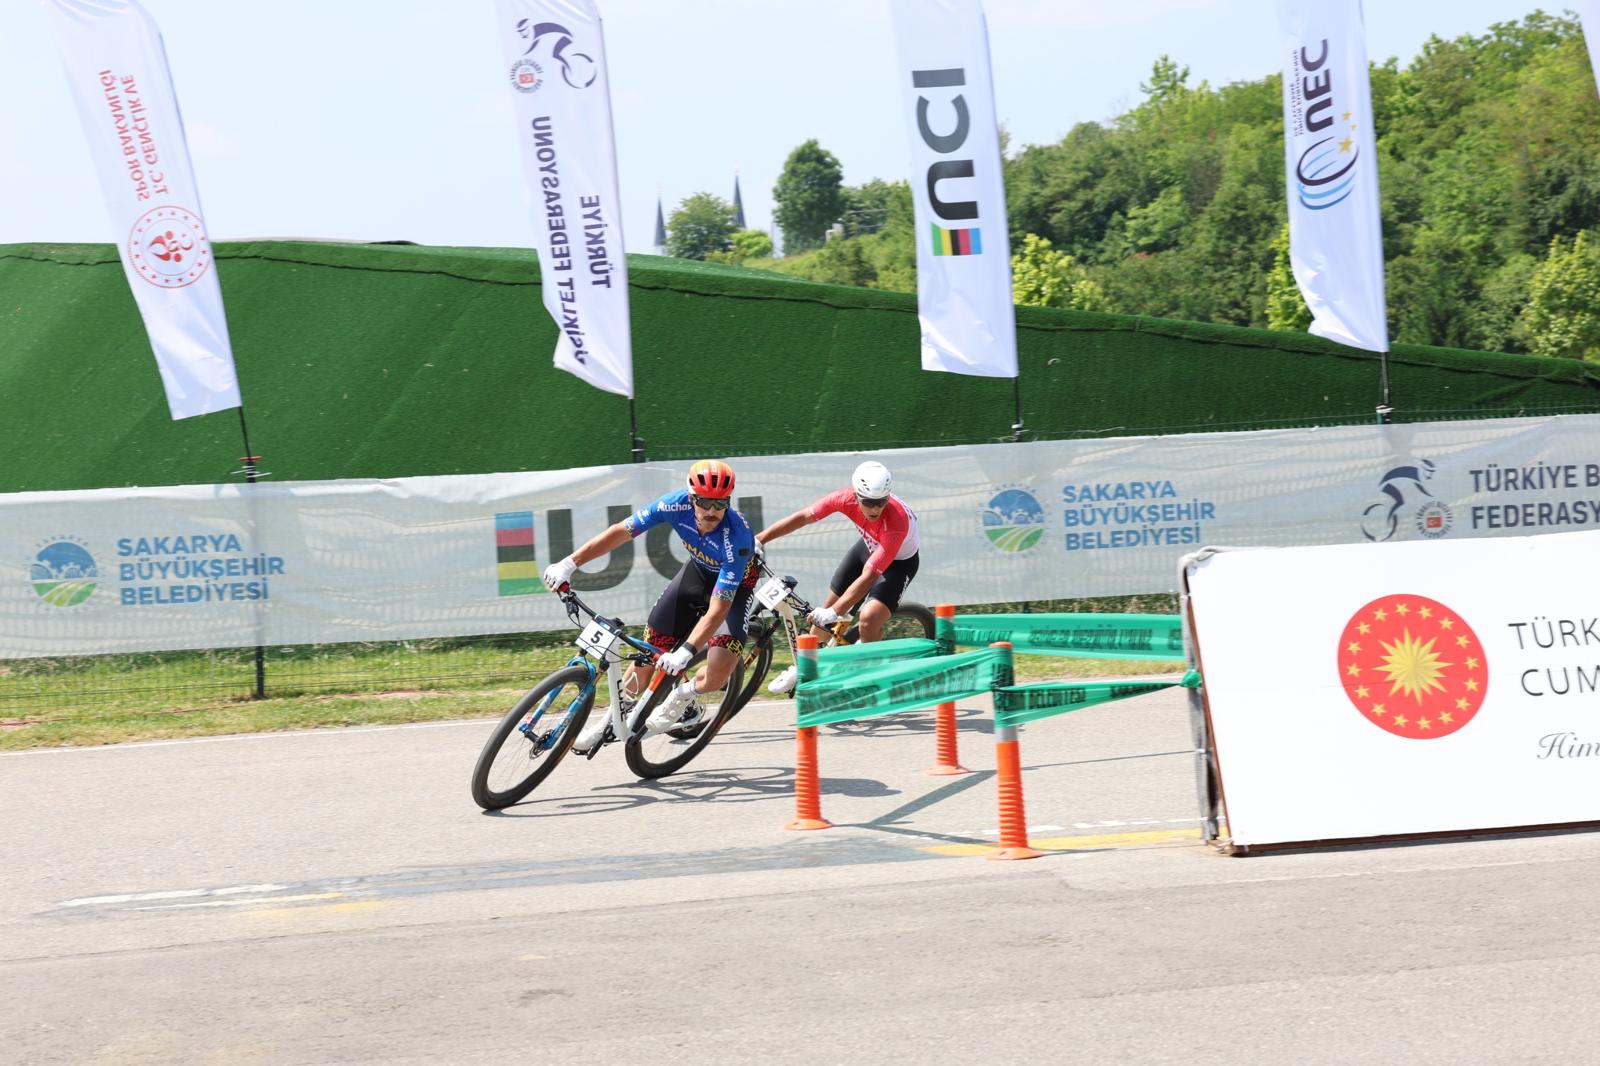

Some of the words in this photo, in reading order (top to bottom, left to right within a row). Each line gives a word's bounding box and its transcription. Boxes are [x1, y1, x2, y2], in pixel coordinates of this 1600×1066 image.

[1469, 461, 1577, 493] TÜRKİYE
[1063, 480, 1176, 503] SAKARYA
[1064, 499, 1216, 527] BÜYÜKŞEHİR
[117, 534, 242, 557] SAKARYA
[723, 527, 735, 563] Auchan
[1065, 522, 1200, 550] BELEDİYESİ
[119, 552, 285, 582] BÜYÜKŞEHİR
[120, 577, 270, 606] BELEDİYESİ
[766, 587, 780, 601] 12
[590, 630, 603, 644] 5
[1508, 616, 1600, 650] TÜRK
